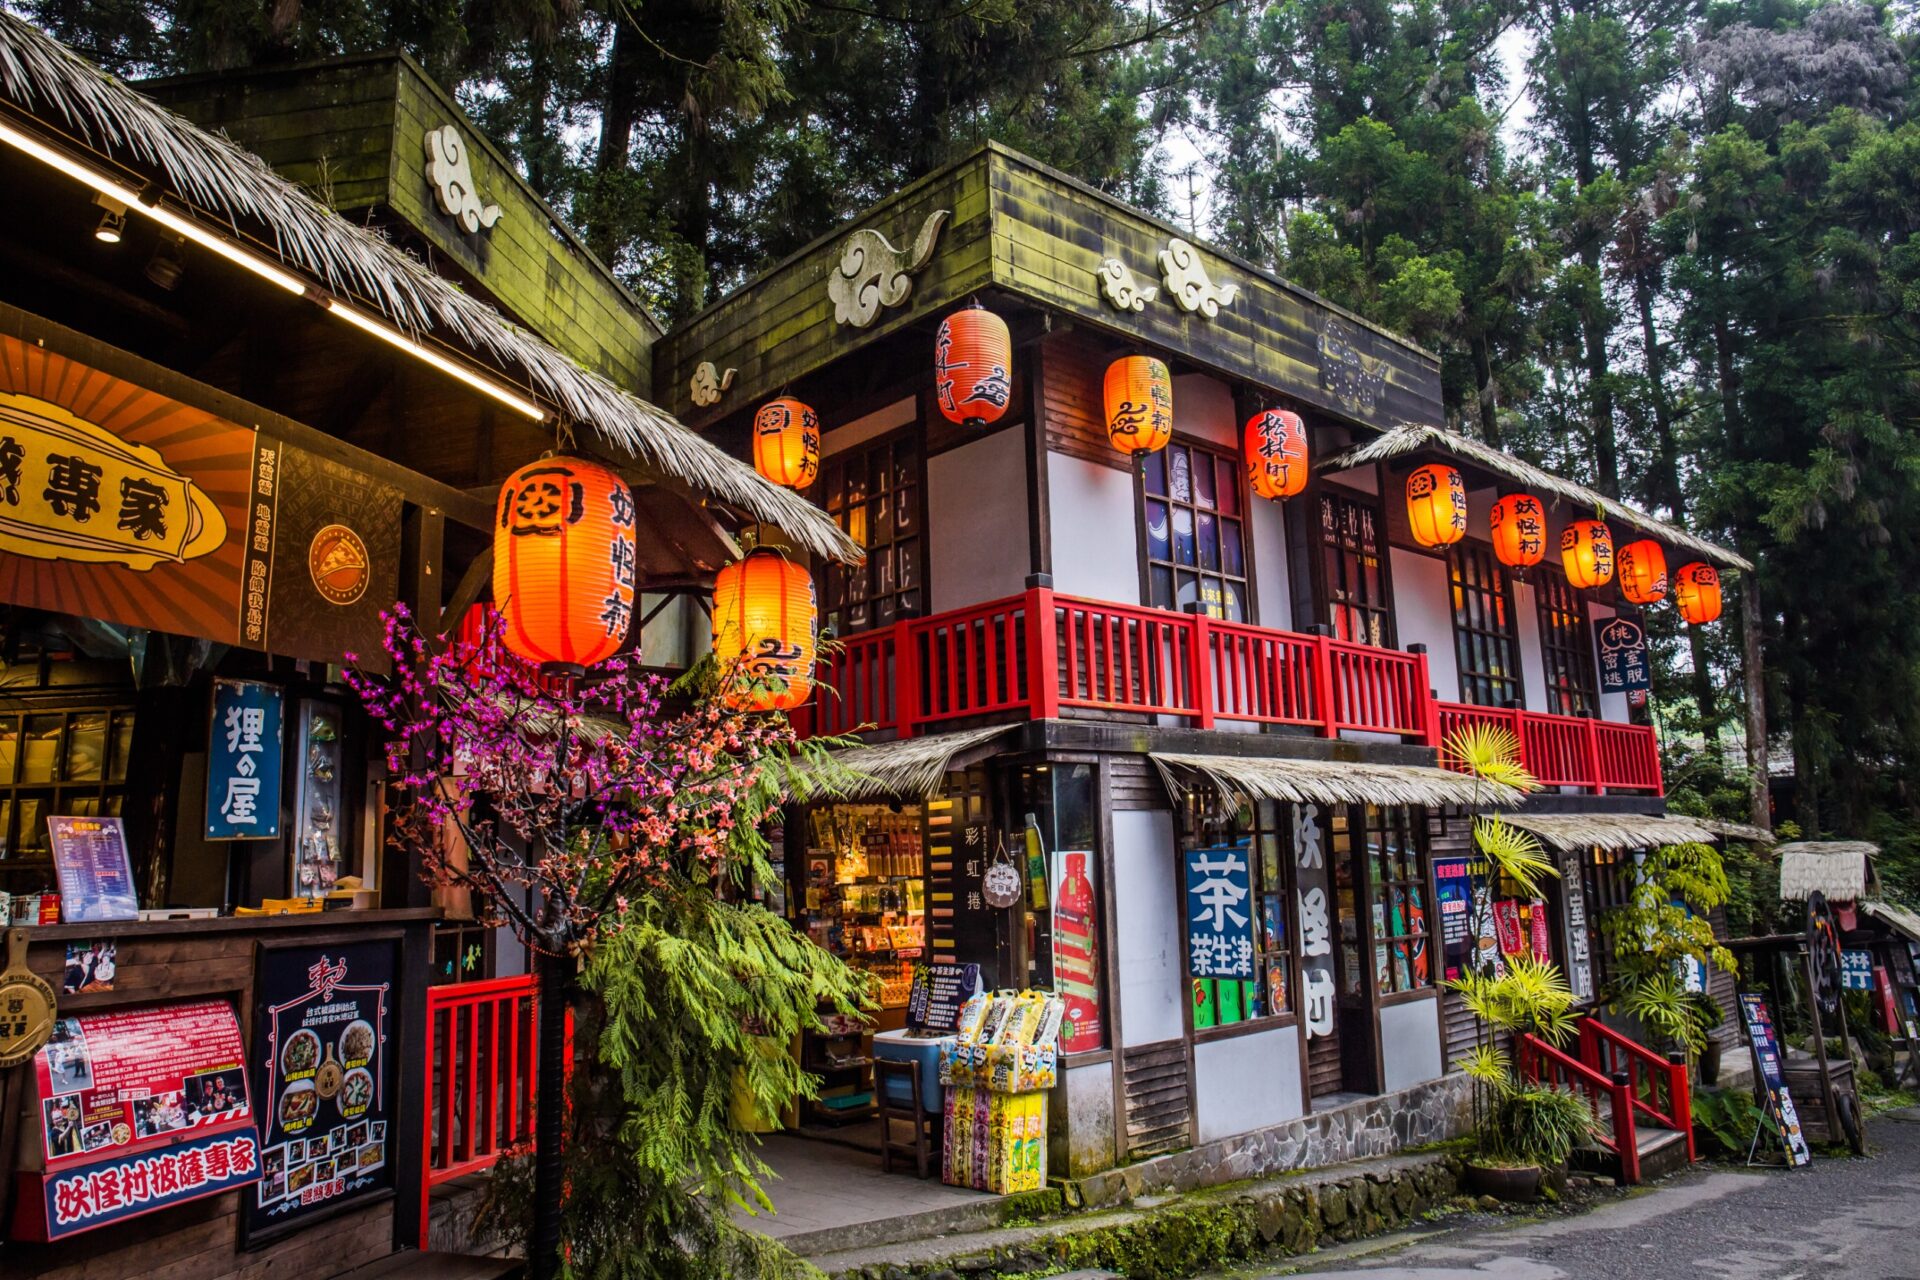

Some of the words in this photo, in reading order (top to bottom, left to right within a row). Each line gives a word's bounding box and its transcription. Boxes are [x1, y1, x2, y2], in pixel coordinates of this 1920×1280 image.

[799, 409, 820, 478] 妖怪村
[1257, 412, 1300, 489] 松林町
[1447, 470, 1467, 532] 妖怪村
[1513, 498, 1541, 555] 妖怪村
[1589, 525, 1612, 576] 妖怪村
[1602, 650, 1643, 671] 密室
[1609, 625, 1632, 640] 桃
[1604, 668, 1648, 687] 逃脫
[221, 706, 265, 825] 狸の屋
[965, 826, 981, 911] 彩虹捲
[1190, 852, 1248, 933] 茶
[1191, 932, 1254, 977] 茶生津
[56, 1136, 257, 1224] 妖怪村披薩專家
